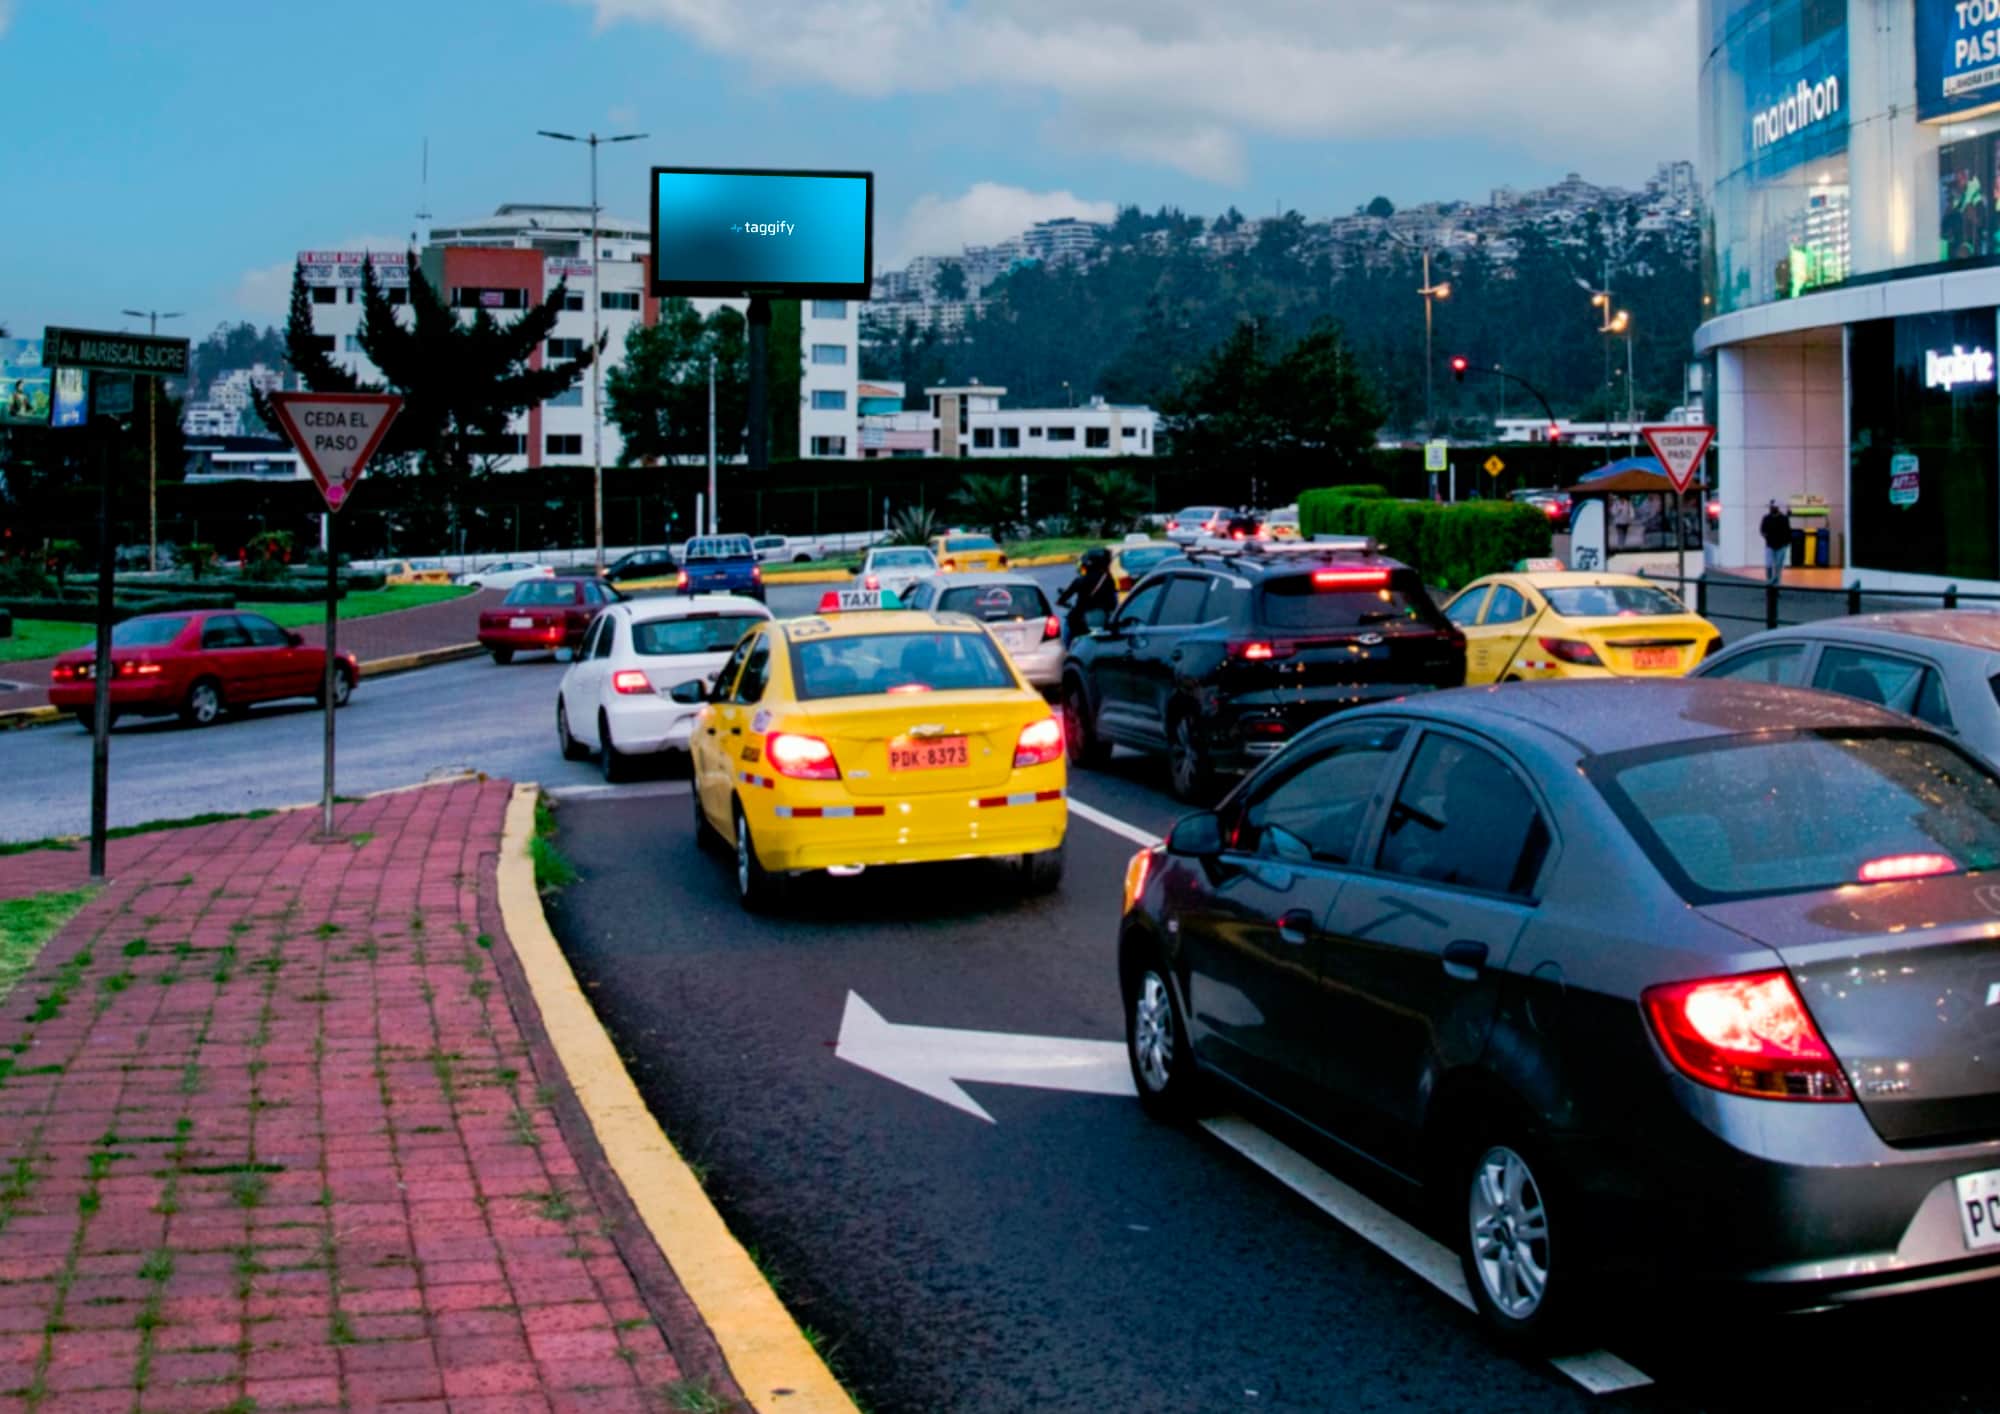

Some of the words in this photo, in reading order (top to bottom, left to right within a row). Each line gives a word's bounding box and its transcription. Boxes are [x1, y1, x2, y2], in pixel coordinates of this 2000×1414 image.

[1955, 0, 2000, 30] TOD
[1753, 74, 1839, 150] marathon
[744, 219, 795, 236] taggify
[79, 339, 141, 365] MARISCAL
[144, 344, 185, 368] SUCRE
[304, 410, 346, 427] CEDA
[350, 411, 369, 428] EL
[315, 434, 358, 451] PASO
[1660, 435, 1684, 446] CEDA
[1686, 435, 1698, 446] EL
[1667, 449, 1692, 460] PASO
[842, 592, 878, 607] TAXI
